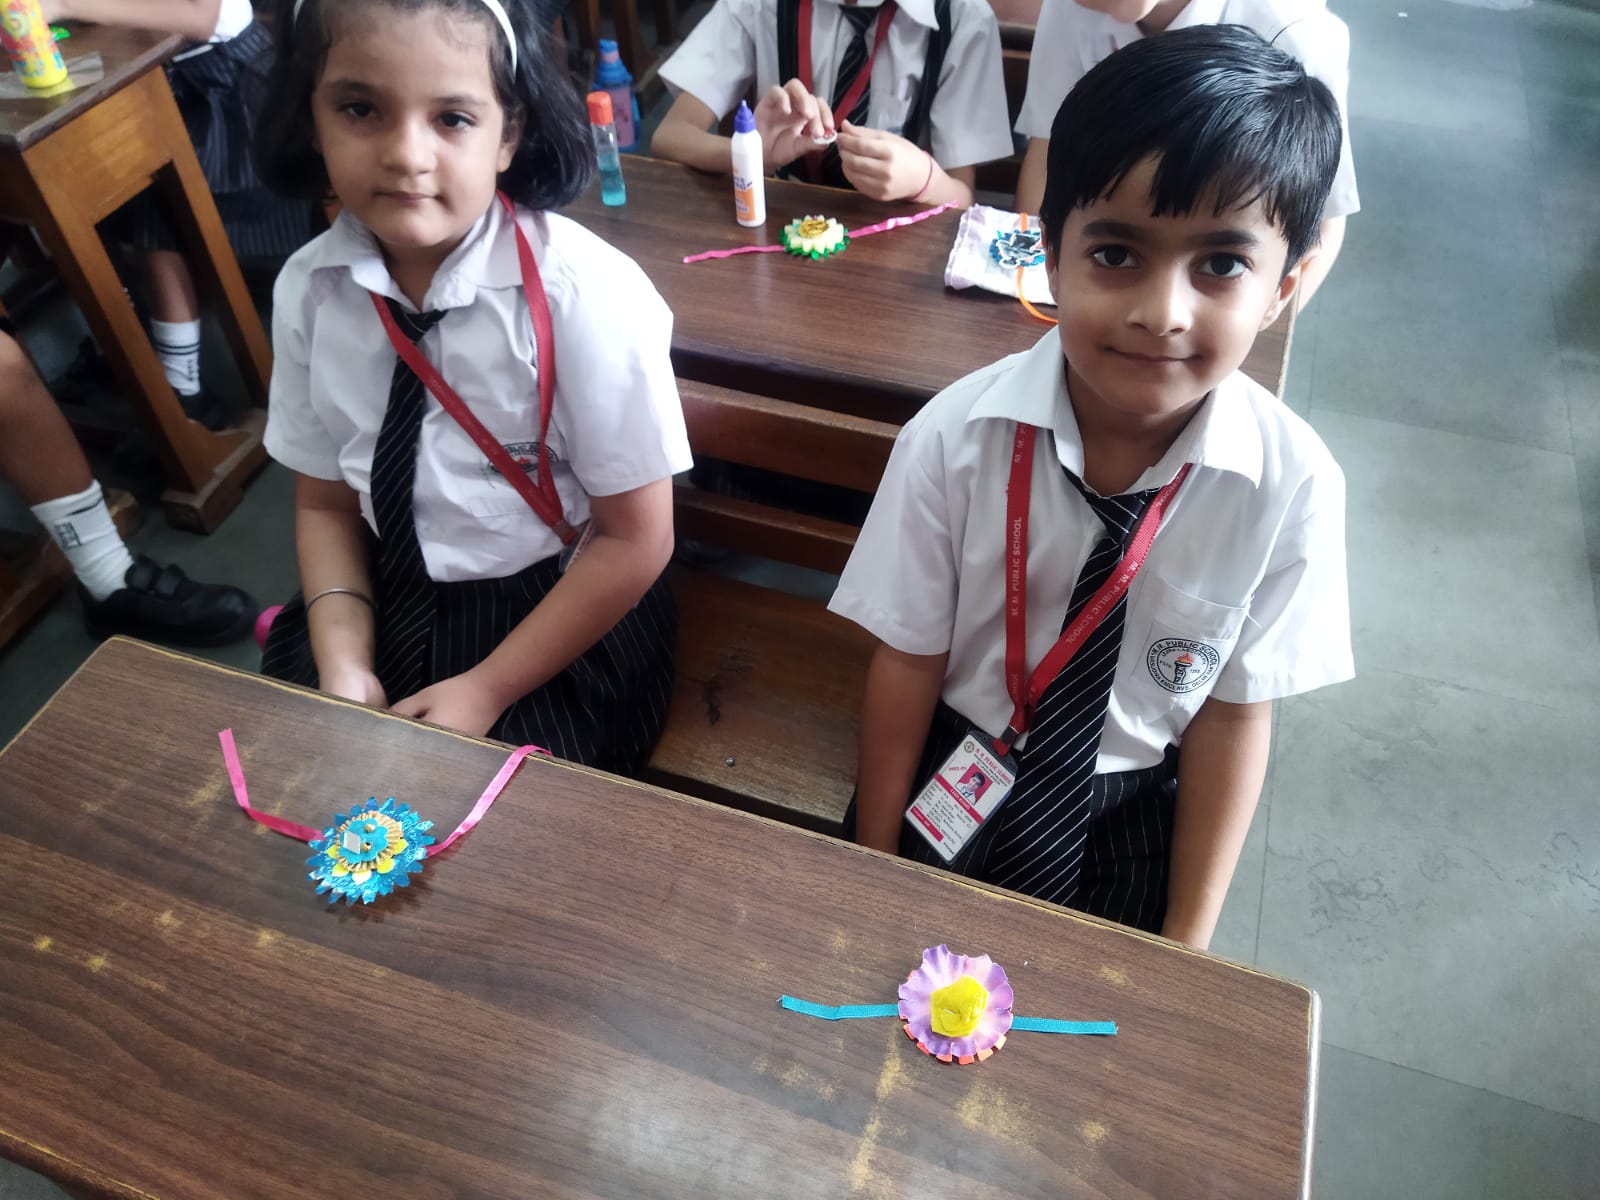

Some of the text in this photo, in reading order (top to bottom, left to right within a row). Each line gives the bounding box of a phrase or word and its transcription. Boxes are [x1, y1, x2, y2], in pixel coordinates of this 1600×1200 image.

[1013, 516, 1022, 555] SCHOOL
[1012, 558, 1021, 591] PUBLIC
[1091, 584, 1120, 614] PUBLIC
[1065, 614, 1094, 645] SCHOOL
[1166, 640, 1198, 649] PUBLIC
[1199, 645, 1218, 668] SCHOOL
